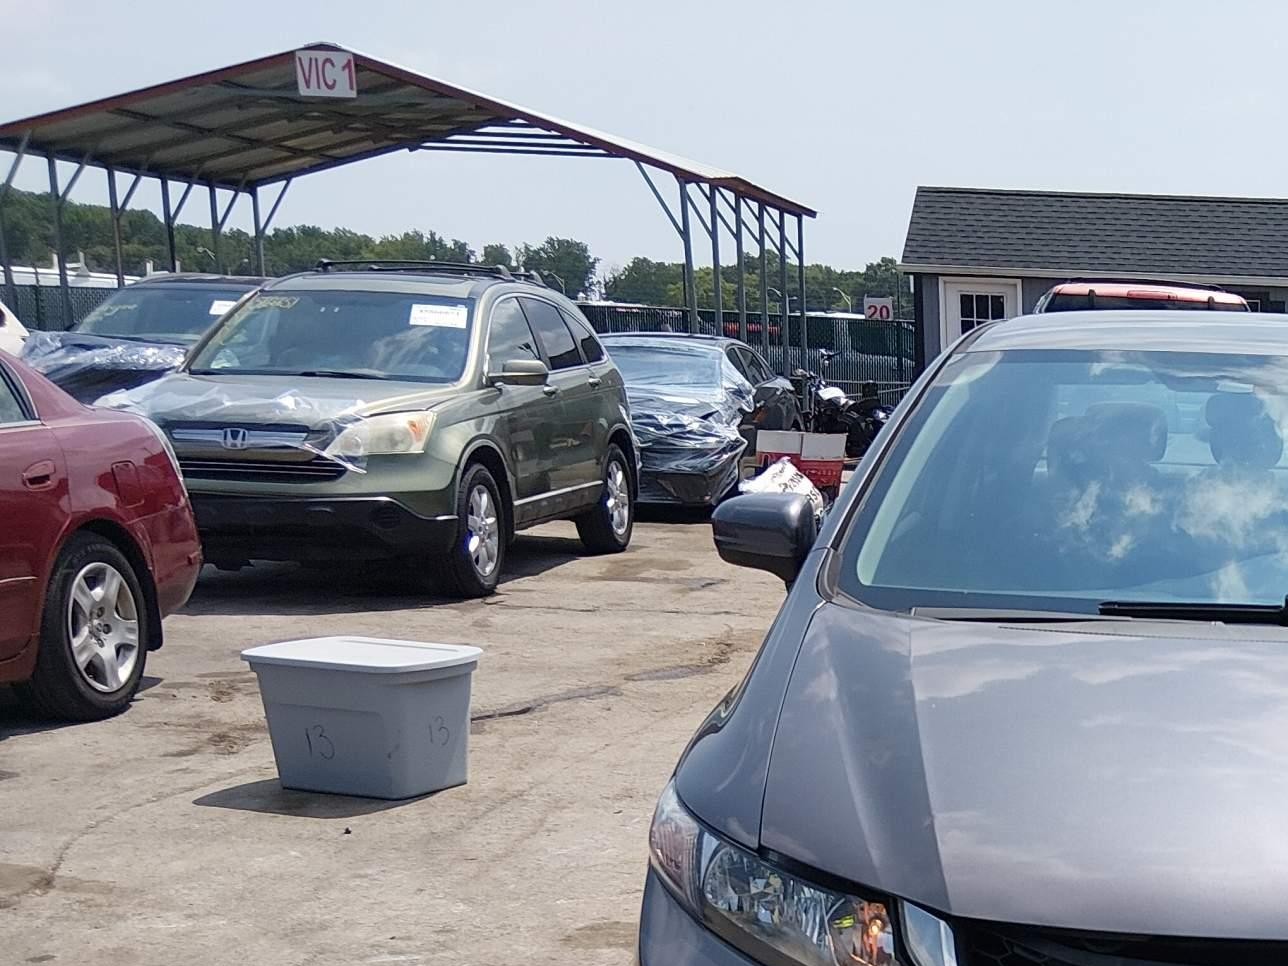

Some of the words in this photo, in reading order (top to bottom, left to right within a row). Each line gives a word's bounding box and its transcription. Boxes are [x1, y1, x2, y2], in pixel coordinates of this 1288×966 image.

[298, 56, 337, 90] VIC
[341, 57, 354, 91] 1
[867, 304, 890, 320] 20
[304, 724, 336, 760] 13
[428, 715, 450, 746] 13
